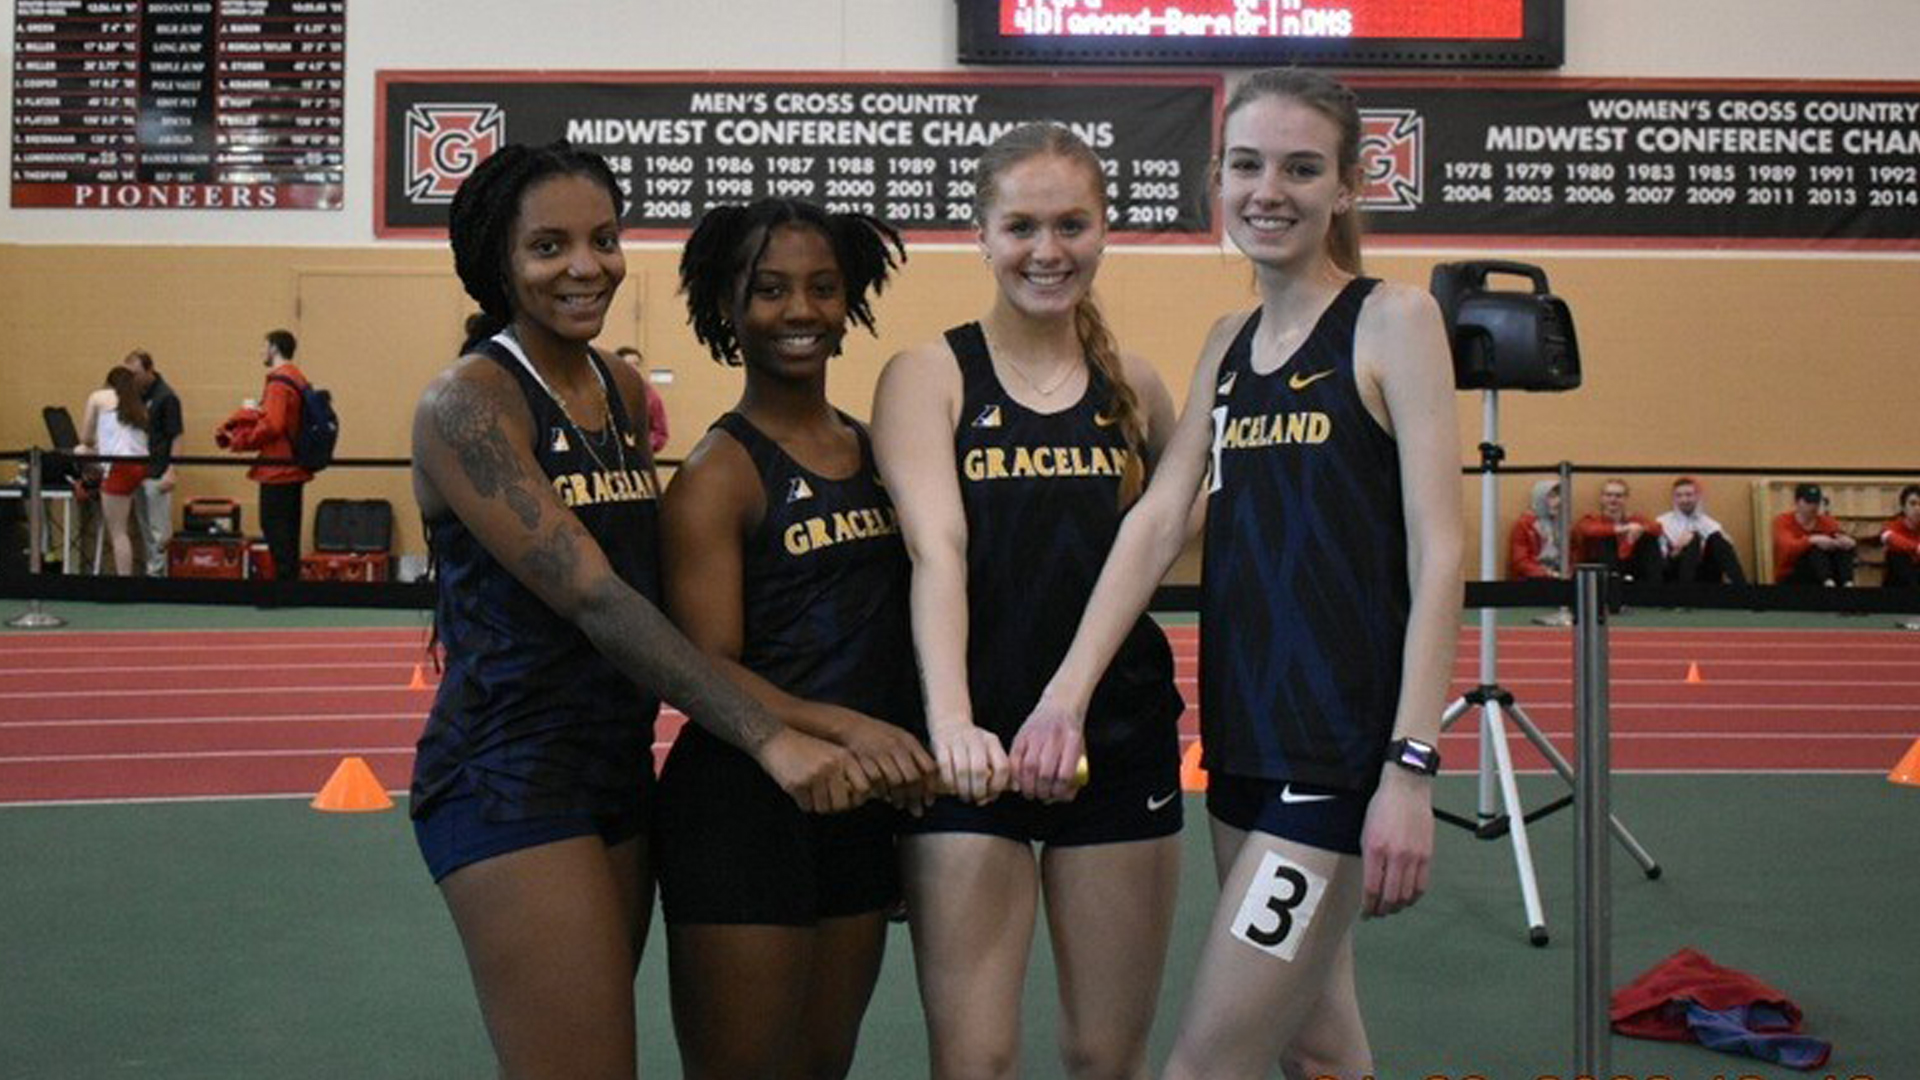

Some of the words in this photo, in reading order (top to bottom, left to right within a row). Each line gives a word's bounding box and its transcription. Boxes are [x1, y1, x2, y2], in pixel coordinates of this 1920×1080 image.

[690, 93, 768, 113] MEN'S
[775, 93, 853, 114] CROSS
[861, 94, 977, 114] COUNTRY
[1589, 101, 1711, 121] WOMEN'S
[1719, 101, 1797, 121] CROSS
[1804, 102, 1919, 122] COUNTRY
[566, 119, 706, 144] MIDWEST
[715, 120, 912, 146] CONFERENCE
[922, 121, 1114, 147] CHAMNS
[1486, 126, 1627, 151] MIDWEST
[1637, 127, 1833, 153] CONFERENCE
[645, 156, 693, 174] 1960
[706, 156, 754, 174] 1986
[766, 156, 814, 174] 1987
[827, 157, 875, 174] 1988
[888, 158, 937, 175] 1989
[1132, 160, 1180, 177] 1993
[1445, 163, 1493, 179] 1978
[1506, 163, 1554, 180] 1979
[1567, 164, 1615, 180] 1980
[1628, 164, 1675, 181] 1983
[1689, 165, 1736, 181] 1985
[1749, 166, 1797, 181] 1989
[1810, 166, 1854, 182] 1991
[1870, 166, 1917, 183] 1992
[76, 185, 277, 207] PIONEERS
[645, 178, 692, 195] 1997
[706, 179, 753, 196] 1998
[766, 180, 814, 196] 1999
[826, 180, 875, 197] 2000
[887, 180, 933, 197] 2001
[1130, 182, 1179, 199] 2005
[1443, 186, 1493, 202] 2004
[1505, 186, 1553, 203] 2005
[1566, 186, 1615, 203] 2006
[1626, 187, 1675, 204] 2007
[1687, 187, 1736, 204] 2009
[1748, 188, 1795, 204] 2011
[1808, 188, 1857, 205] 2013
[1869, 189, 1918, 206] 2014
[643, 201, 692, 218] 2008
[887, 203, 935, 219] 2013
[947, 203, 972, 219] 20
[1128, 206, 1178, 222] 2019
[1222, 411, 1331, 448] ACELAND
[965, 446, 1128, 481] GRACELAN
[784, 508, 890, 555] GRACEL
[1246, 866, 1309, 947] 3
